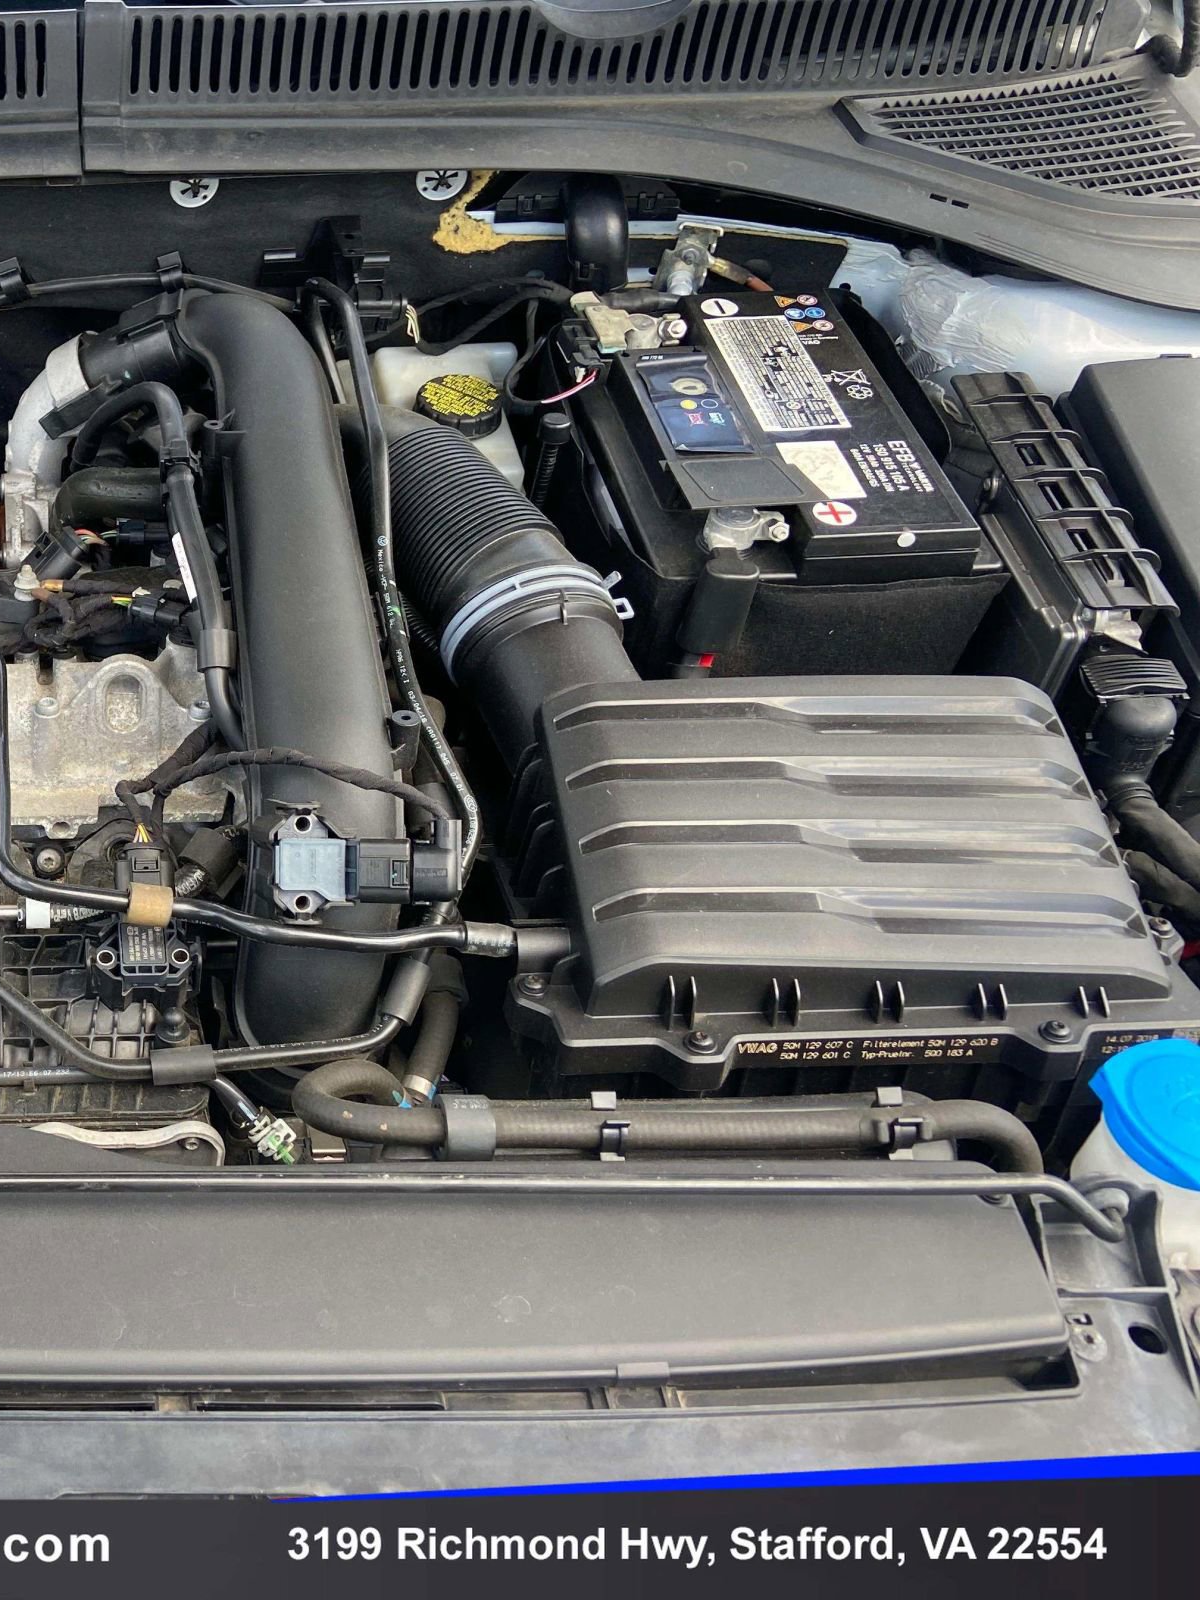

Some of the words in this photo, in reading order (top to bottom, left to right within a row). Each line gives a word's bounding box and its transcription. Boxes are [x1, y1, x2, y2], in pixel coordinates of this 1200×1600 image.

[887, 440, 916, 463] EFB
[737, 1041, 778, 1055] VWAG
[804, 1041, 822, 1049] 129
[950, 1039, 968, 1047] 129
[799, 1051, 819, 1060] 129
[822, 1051, 839, 1059] 601
[842, 1050, 851, 1059] C
[965, 1048, 974, 1056] A
